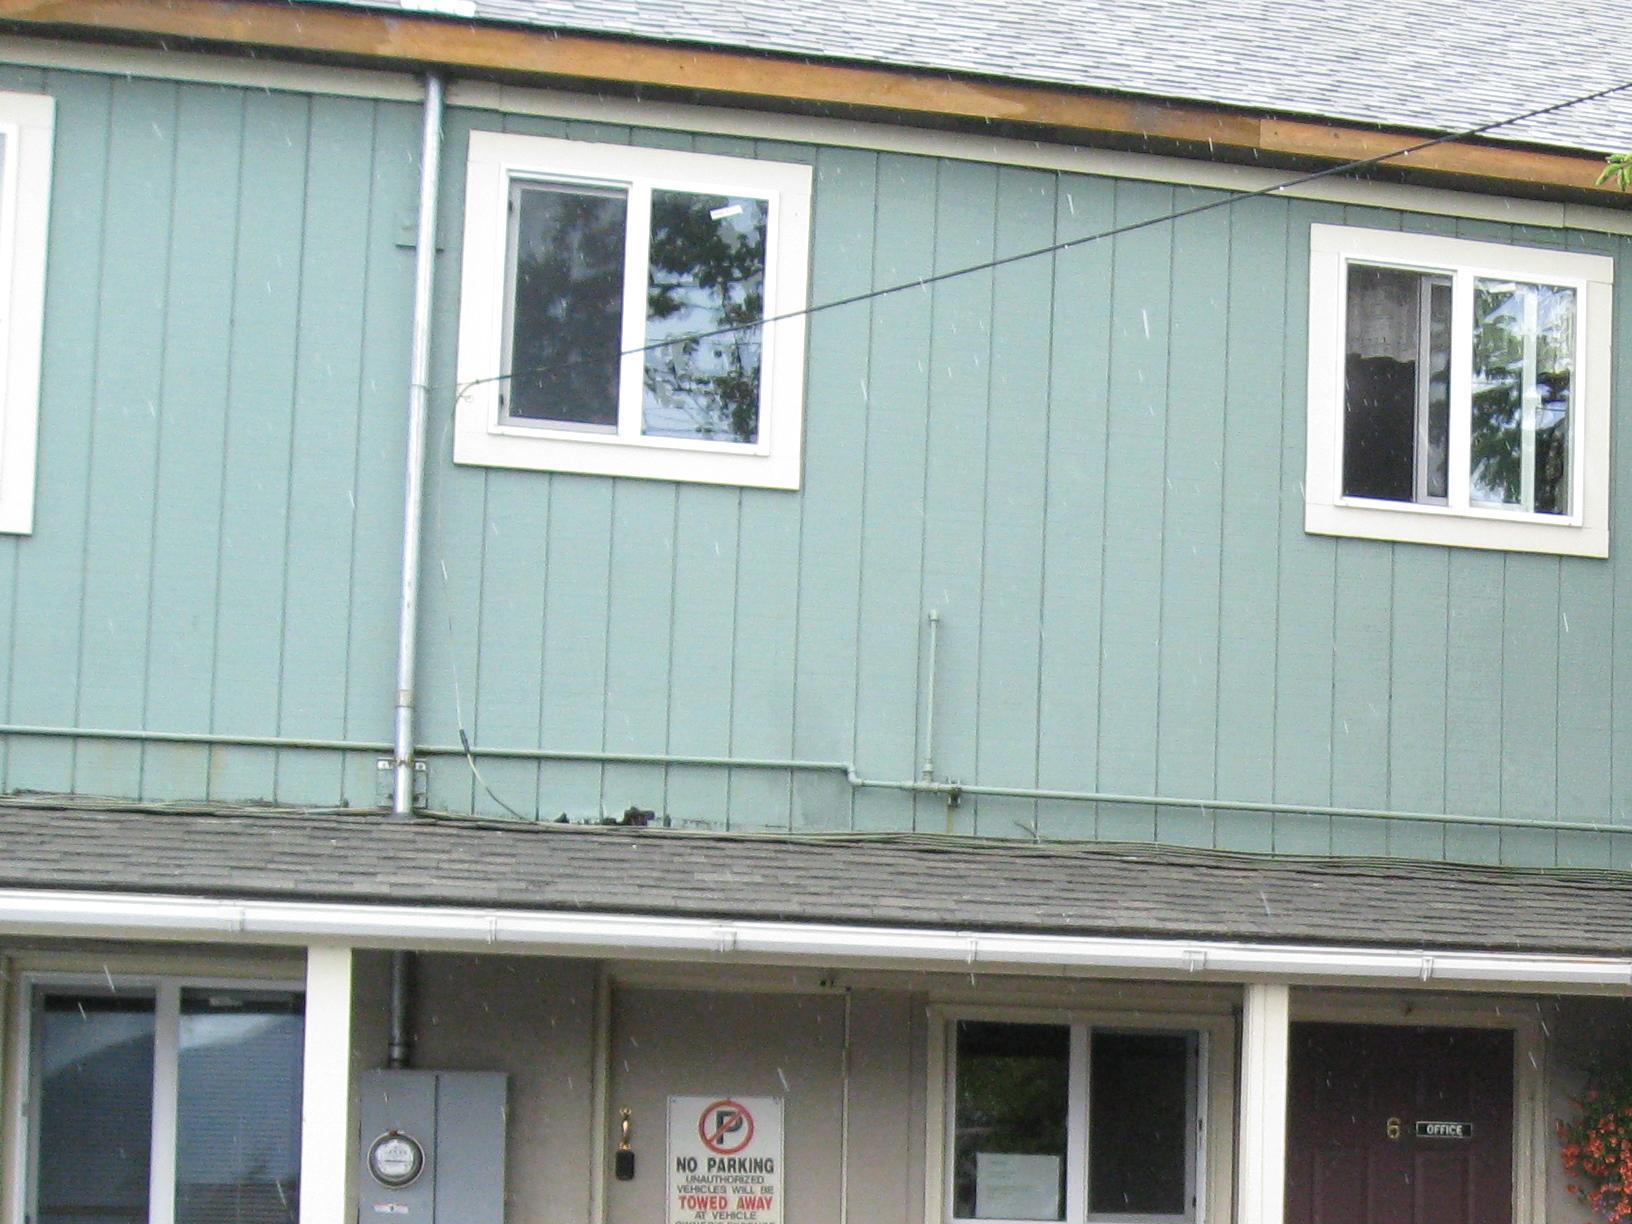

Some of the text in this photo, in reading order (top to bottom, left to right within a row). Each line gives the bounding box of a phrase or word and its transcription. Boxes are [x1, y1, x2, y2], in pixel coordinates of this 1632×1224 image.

[1386, 1117, 1400, 1139] 6
[1426, 1124, 1463, 1136] OFFICE
[676, 1157, 774, 1174] NO PARKING
[686, 1175, 765, 1185] UNAUTHORIZED
[677, 1185, 774, 1194] VEHICLES WILL BE
[678, 1196, 773, 1210] TOWED AWAY
[694, 1211, 757, 1220] AT VEHICLE
